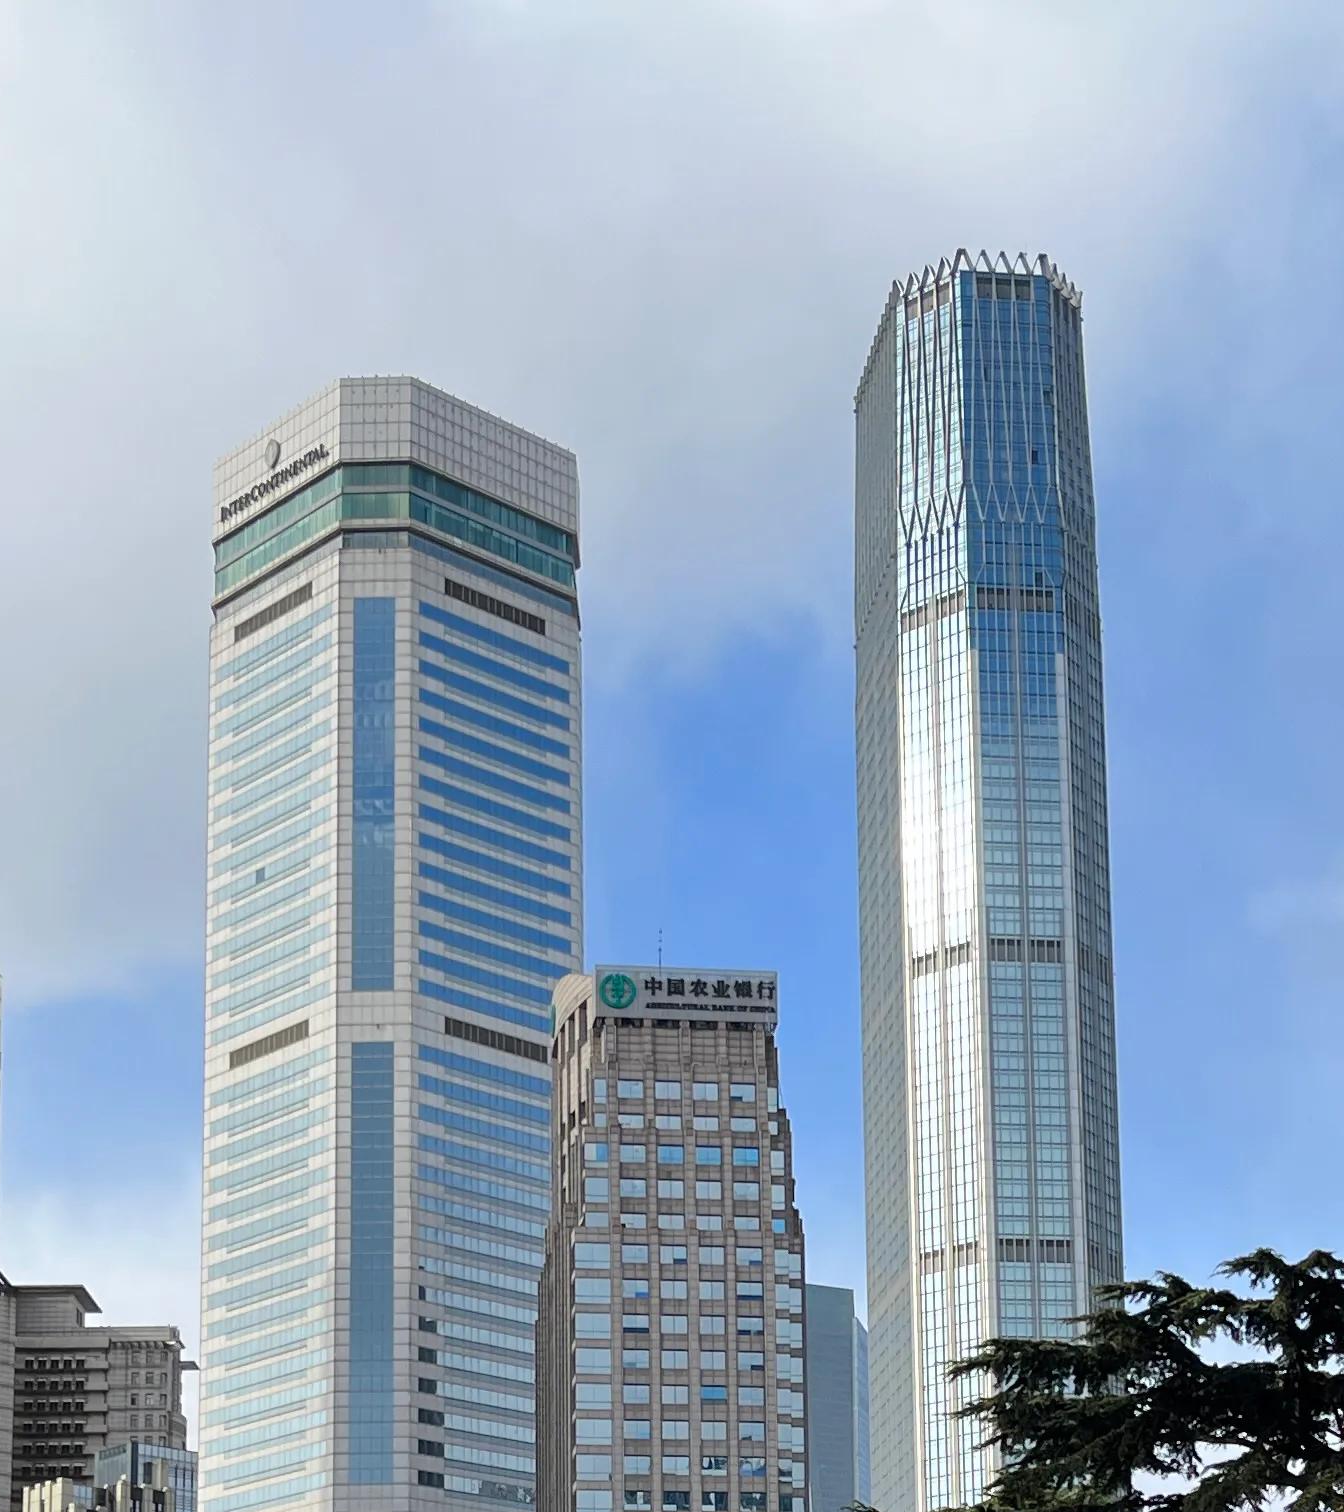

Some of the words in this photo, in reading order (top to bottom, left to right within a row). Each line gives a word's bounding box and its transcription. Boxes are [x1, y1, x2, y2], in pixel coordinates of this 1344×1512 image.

[643, 976, 776, 1000] 中国农业银行
